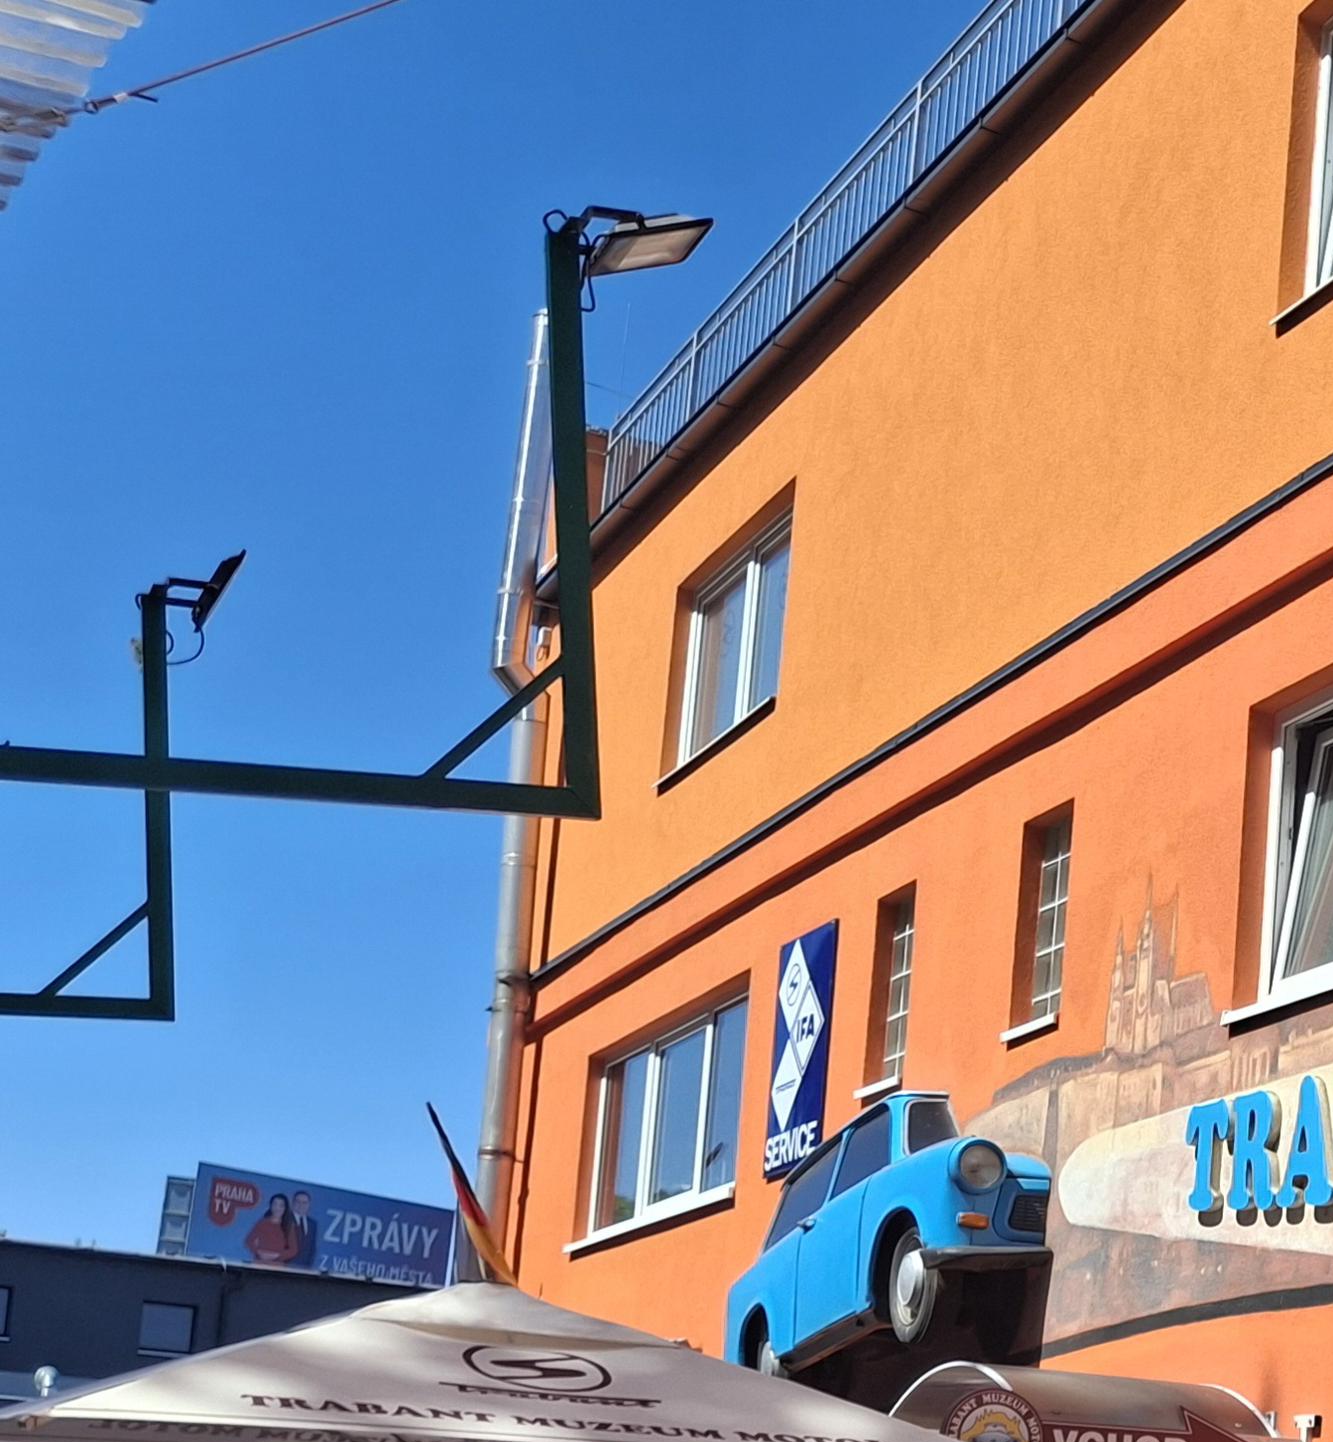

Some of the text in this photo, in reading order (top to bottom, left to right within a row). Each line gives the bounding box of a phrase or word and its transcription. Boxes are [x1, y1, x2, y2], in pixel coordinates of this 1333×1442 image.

[796, 1013, 815, 1043] IFA
[764, 1120, 818, 1172] SERVICE
[214, 1183, 255, 1204] PRAHA
[214, 1199, 231, 1215] TV
[323, 1208, 439, 1259] ZPRÁVY
[319, 1255, 329, 1270] Z
[333, 1255, 386, 1278] VAŠEHO
[981, 1393, 1029, 1415] MUZEUM
[240, 1394, 496, 1423] TRABANT
[511, 1415, 723, 1441] MUZEUM
